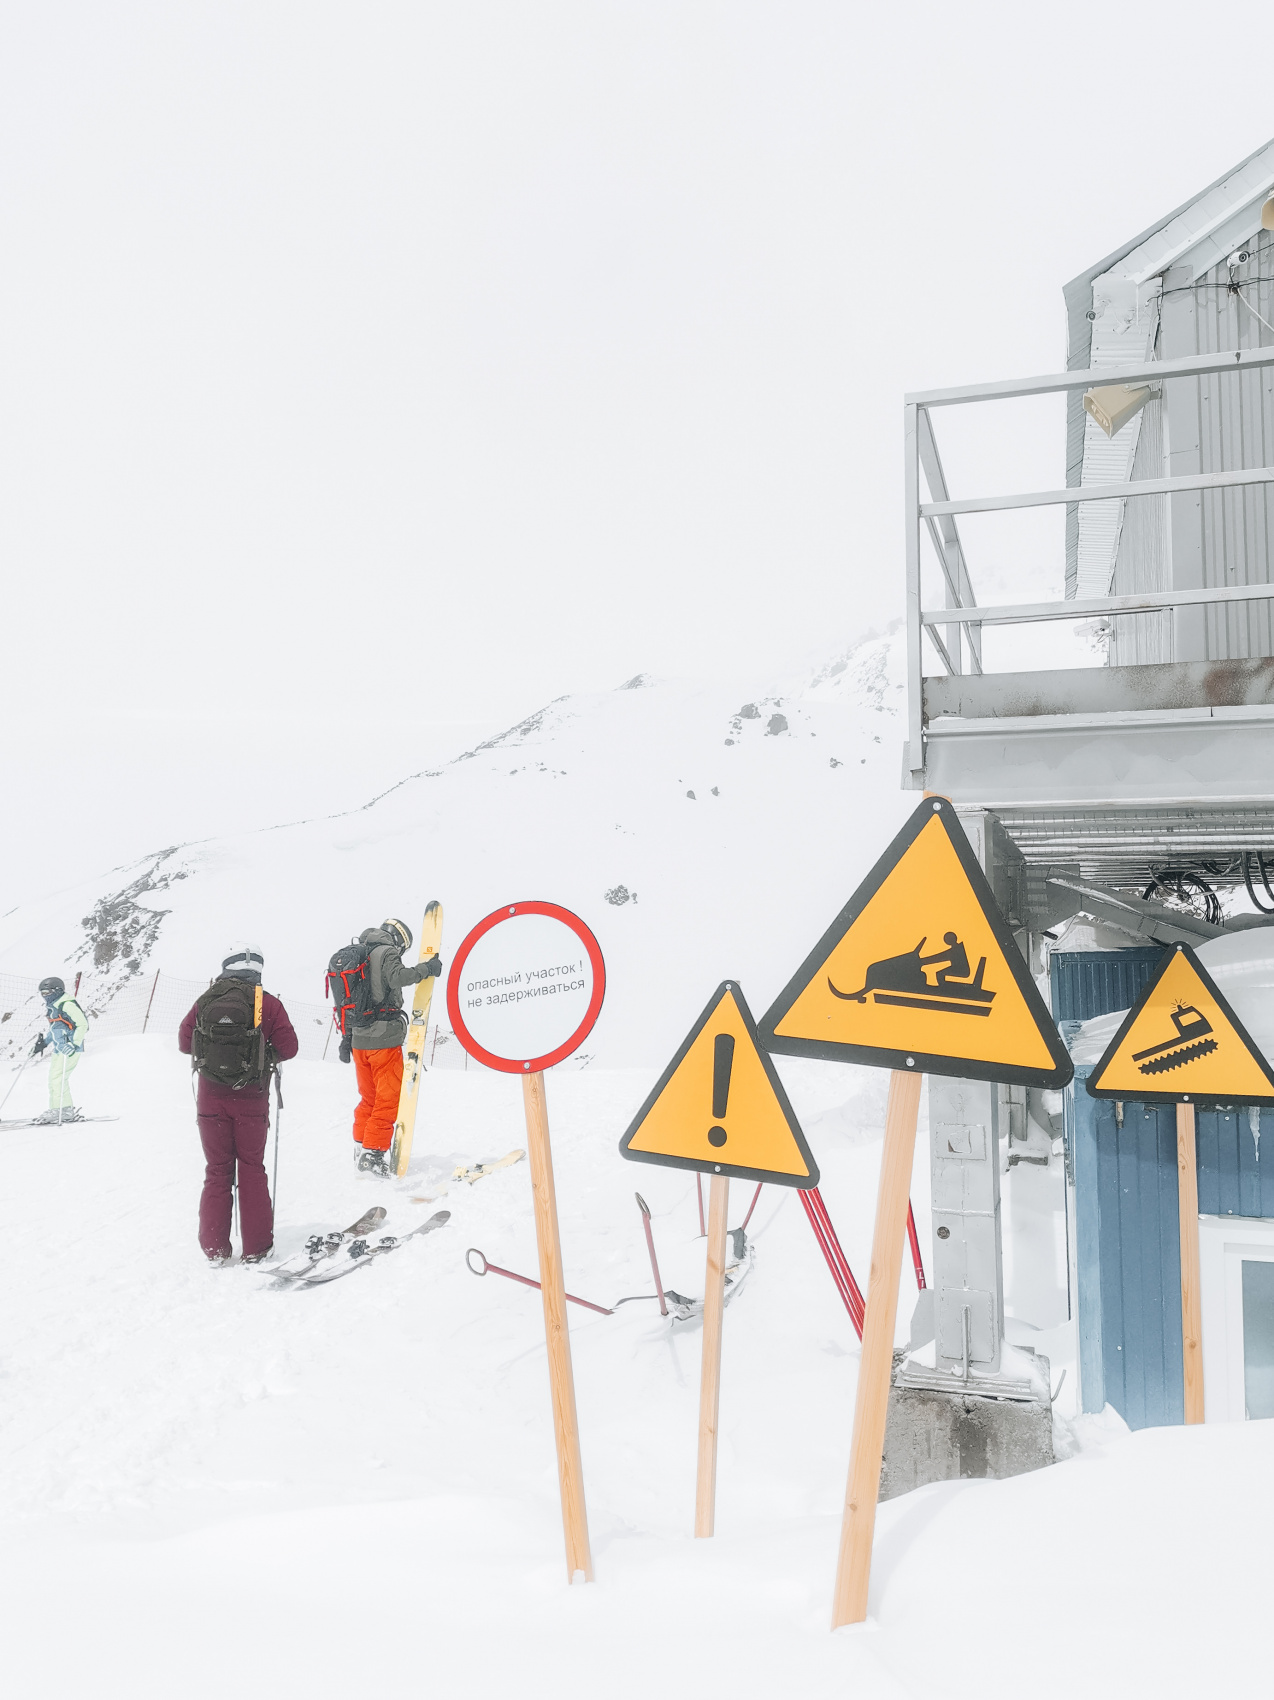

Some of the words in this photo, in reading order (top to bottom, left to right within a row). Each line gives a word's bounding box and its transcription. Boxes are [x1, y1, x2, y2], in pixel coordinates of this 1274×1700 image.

[467, 971, 522, 991] опасный
[525, 963, 576, 984] участок
[467, 997, 482, 1008] не
[486, 979, 585, 1005] задерживаться
